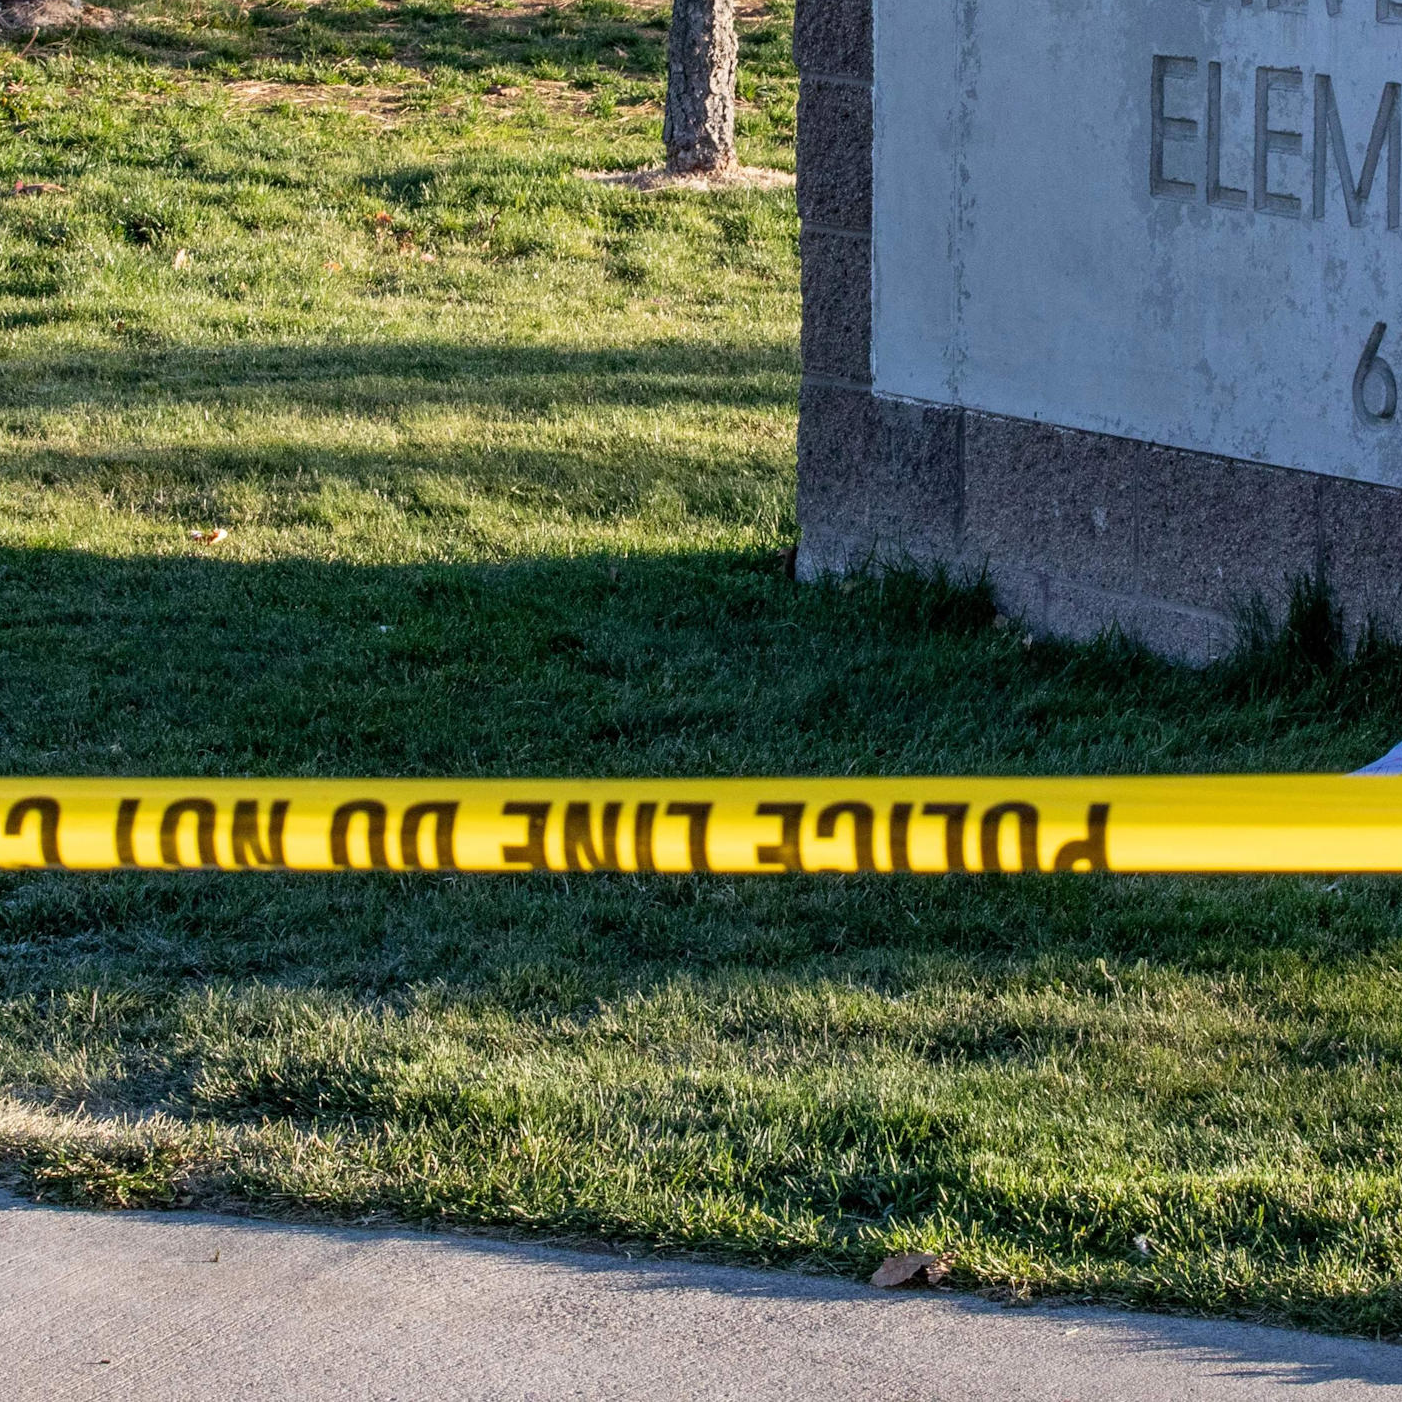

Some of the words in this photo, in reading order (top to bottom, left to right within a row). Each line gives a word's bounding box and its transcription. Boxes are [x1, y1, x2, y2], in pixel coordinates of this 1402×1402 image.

[114, 798, 290, 869] NOT
[331, 799, 461, 869] DO
[501, 800, 714, 870] LINE
[755, 801, 1110, 871] POLICE
